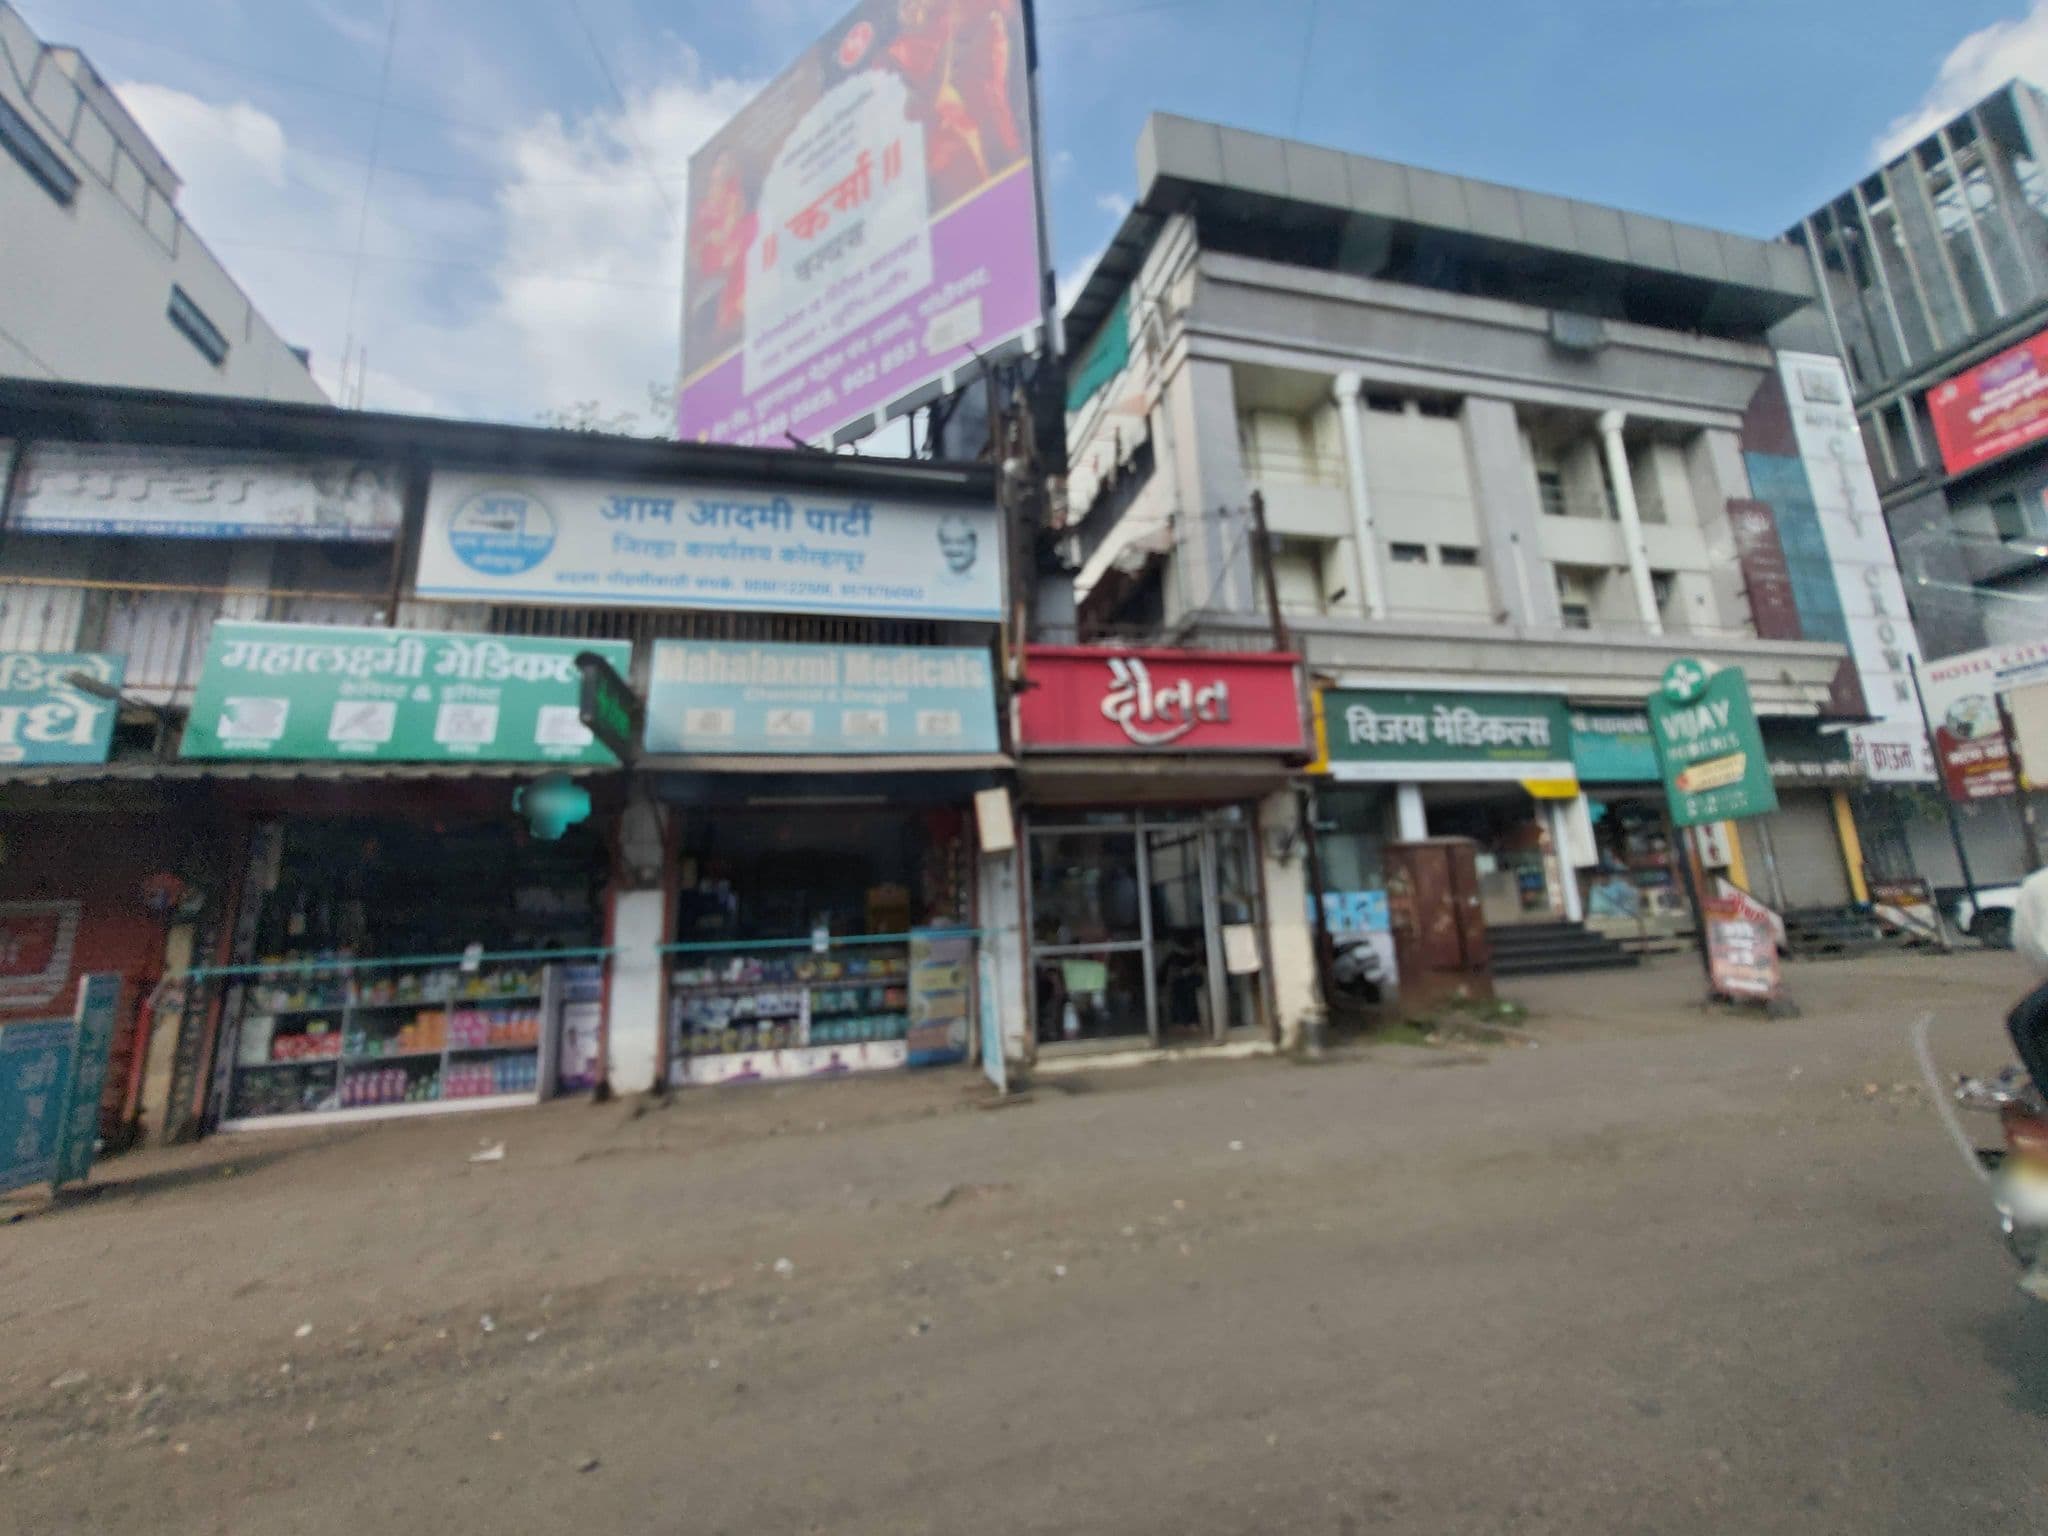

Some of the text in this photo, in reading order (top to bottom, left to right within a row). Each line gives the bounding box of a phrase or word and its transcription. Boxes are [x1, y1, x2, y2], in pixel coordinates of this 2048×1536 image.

[600, 494, 873, 538] आम आदमी पार्टी
[219, 637, 429, 678] महालक्ष्मी
[656, 646, 986, 689] Mahalaxmi Medicals
[1345, 704, 1428, 745] विजय
[1432, 704, 1550, 746] मेडिकल्स
[1660, 700, 1730, 741] VIJAY
